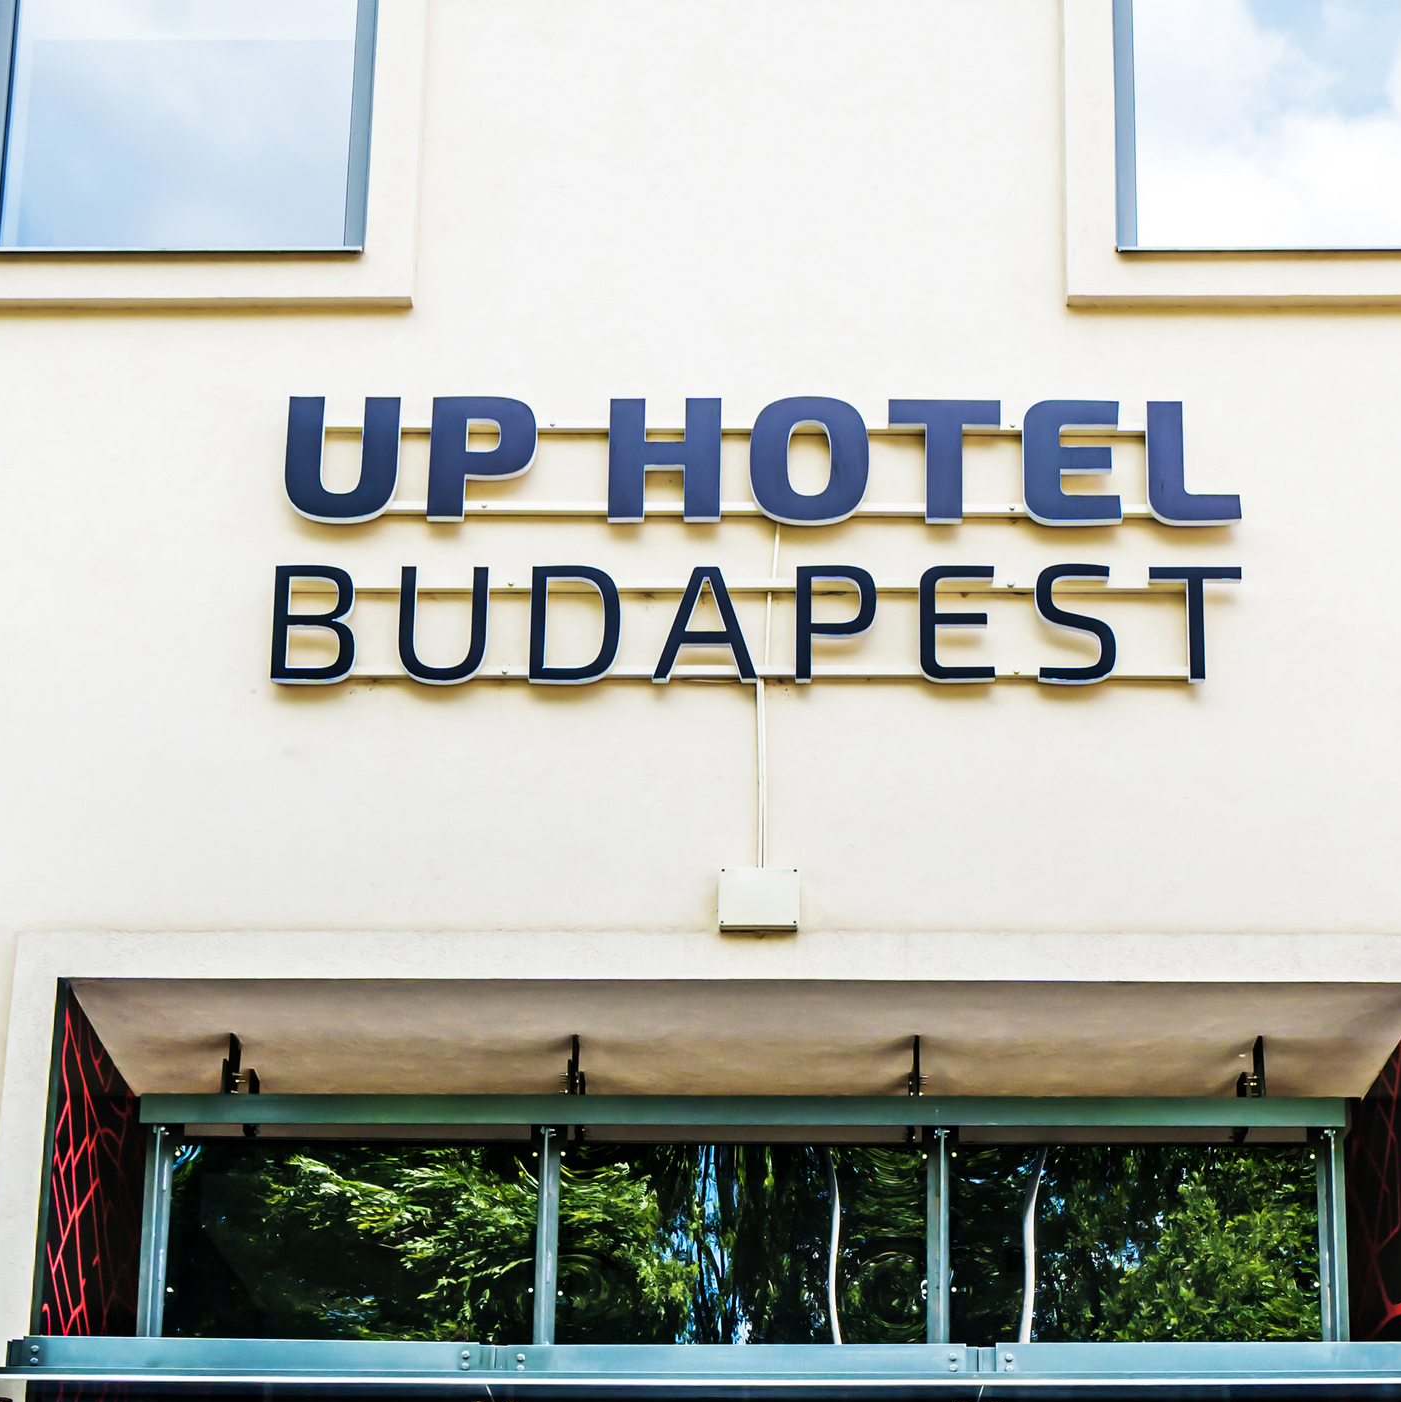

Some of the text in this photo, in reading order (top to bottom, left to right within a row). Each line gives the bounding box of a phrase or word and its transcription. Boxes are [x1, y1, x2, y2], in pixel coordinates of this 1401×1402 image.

[284, 395, 1243, 526] UP HOTEL
[269, 563, 1243, 686] BUDAPEST
